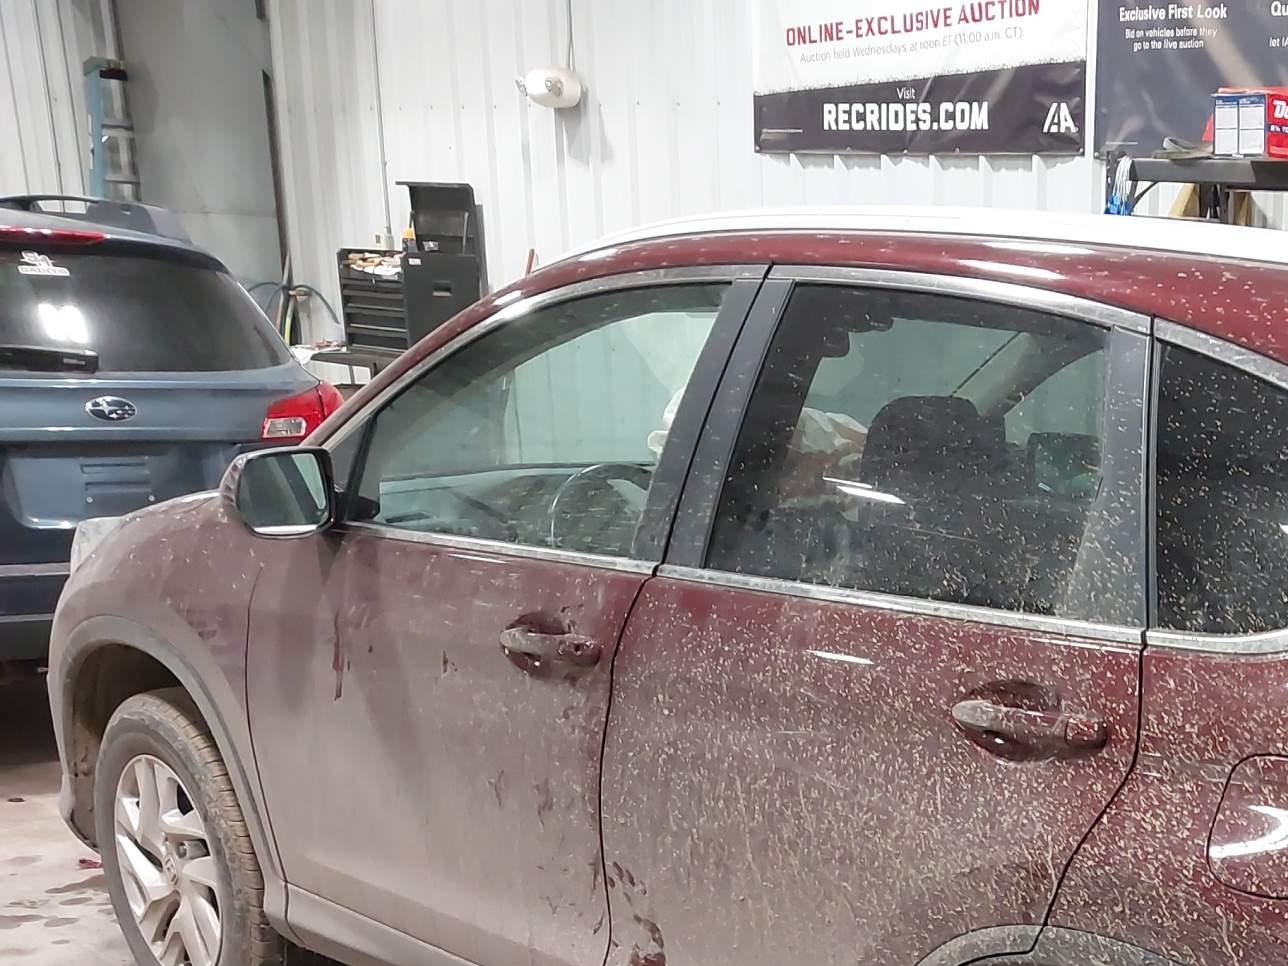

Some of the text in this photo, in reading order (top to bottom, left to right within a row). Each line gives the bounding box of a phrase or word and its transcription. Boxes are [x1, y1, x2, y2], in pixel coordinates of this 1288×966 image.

[1120, 3, 1227, 21] Exclusive First Look
[786, 0, 1040, 46] ONLINE-EXCLUSIVE AUCTION
[1125, 28, 1135, 39] Bid
[1145, 27, 1175, 38] vehicles
[1133, 42, 1142, 52] go
[1143, 40, 1150, 49] to
[1151, 40, 1162, 49] the
[800, 52, 831, 63] Auction
[896, 87, 916, 100] Visit
[823, 101, 989, 131] RECRIDES.COM
